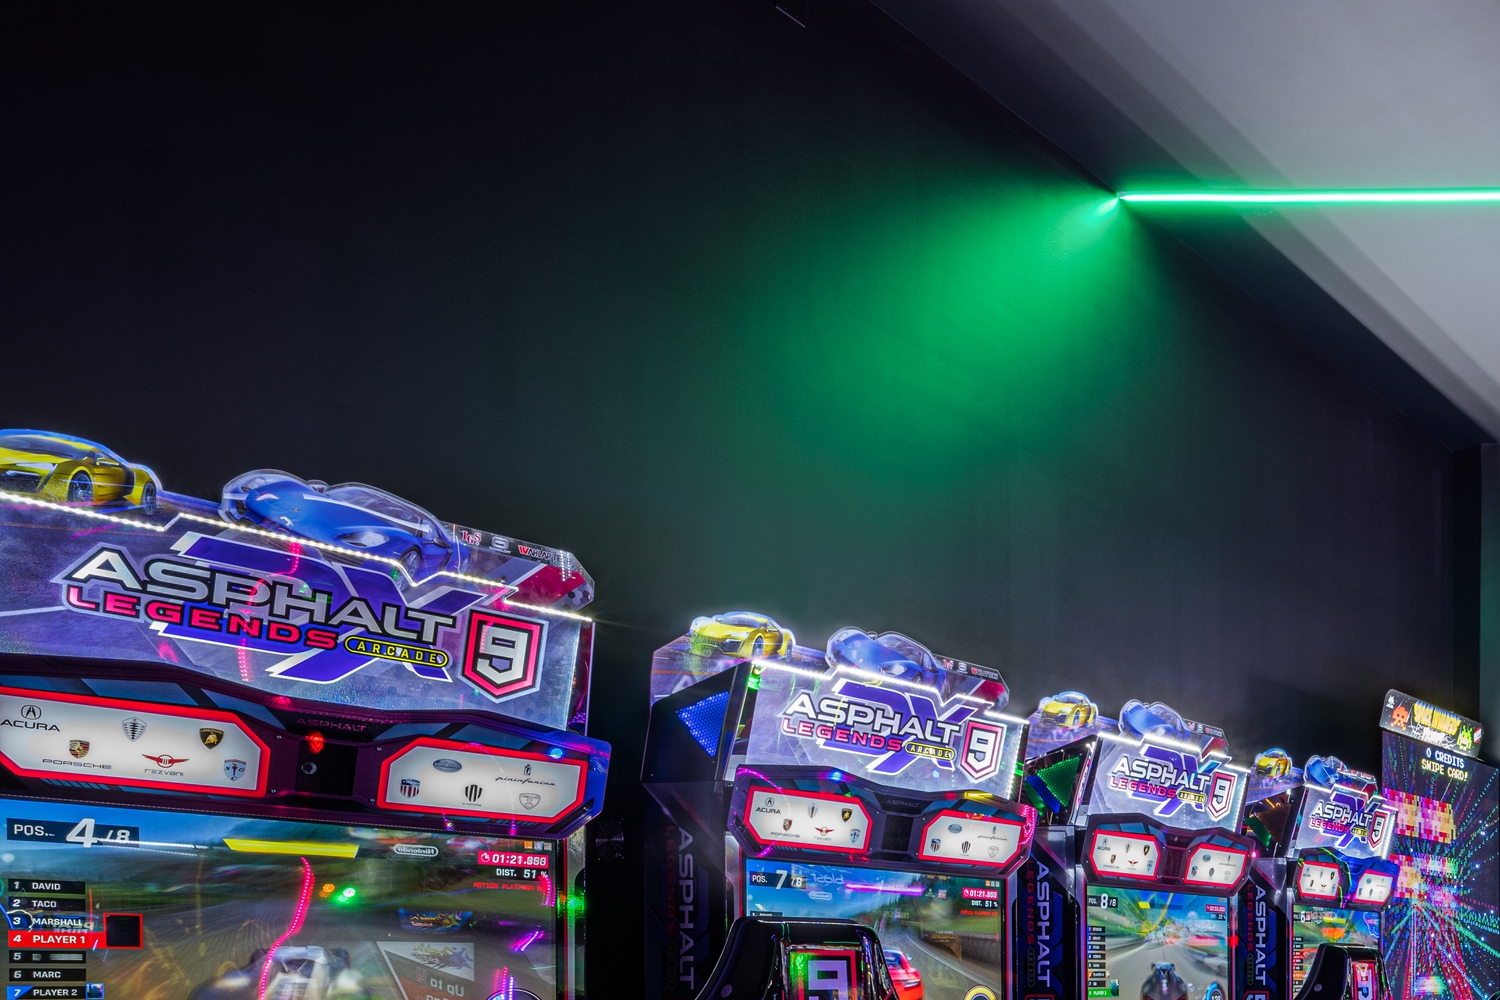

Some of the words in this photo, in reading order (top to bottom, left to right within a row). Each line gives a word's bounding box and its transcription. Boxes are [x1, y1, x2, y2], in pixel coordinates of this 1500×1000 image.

[518, 544, 551, 560] WAHLAP
[65, 549, 456, 643] ASPHALT
[67, 586, 340, 651] LEGENDS
[355, 640, 440, 665] ARCADE
[477, 626, 529, 682] 9
[0, 719, 61, 732] ACURA
[295, 717, 368, 732] ASPHALT
[786, 693, 961, 743] ASPHALT
[782, 717, 903, 752] LEGENDS
[909, 744, 951, 759] ARCADE
[969, 730, 997, 770] 9
[1426, 747, 1432, 758] 0
[1434, 750, 1465, 769] CREDITS
[42, 758, 112, 770] PORSCHE
[1113, 756, 1212, 791] ASPHALT
[1421, 758, 1445, 775] SWIPE
[1447, 767, 1468, 782] CARD!
[1110, 776, 1177, 799] LEGENDS
[1212, 778, 1231, 813] 9
[756, 807, 781, 815] ACURA
[886, 799, 919, 808] ASPHALT
[1312, 801, 1373, 827] ASPHALT
[66, 818, 98, 848] 4
[1310, 818, 1352, 833] LEGENDS
[496, 868, 517, 877] DIST.
[523, 869, 537, 879] 51
[666, 825, 676, 935] LEGENDS
[752, 874, 768, 883] POS.
[775, 869, 788, 890] 7
[13, 881, 20, 889] 1
[32, 882, 61, 891] DAVID
[13, 899, 20, 907] 2
[32, 900, 57, 908] TACO
[678, 826, 695, 990] ASPHALT
[1026, 860, 1035, 945] LEGENDS
[1101, 893, 1109, 909] 8
[13, 917, 20, 925] 3
[33, 918, 83, 926] MARSHALL
[1036, 861, 1050, 988] ASPHALT
[13, 935, 21, 943] 4
[33, 936, 77, 944] PLAYER
[80, 936, 86, 944] 1
[1255, 885, 1266, 986] ASPHALT
[13, 952, 21, 960] 5
[14, 971, 22, 979] 6
[33, 970, 61, 979] MARC
[14, 988, 21, 997] 7
[33, 988, 69, 997] PLAYER
[71, 988, 78, 997] 2
